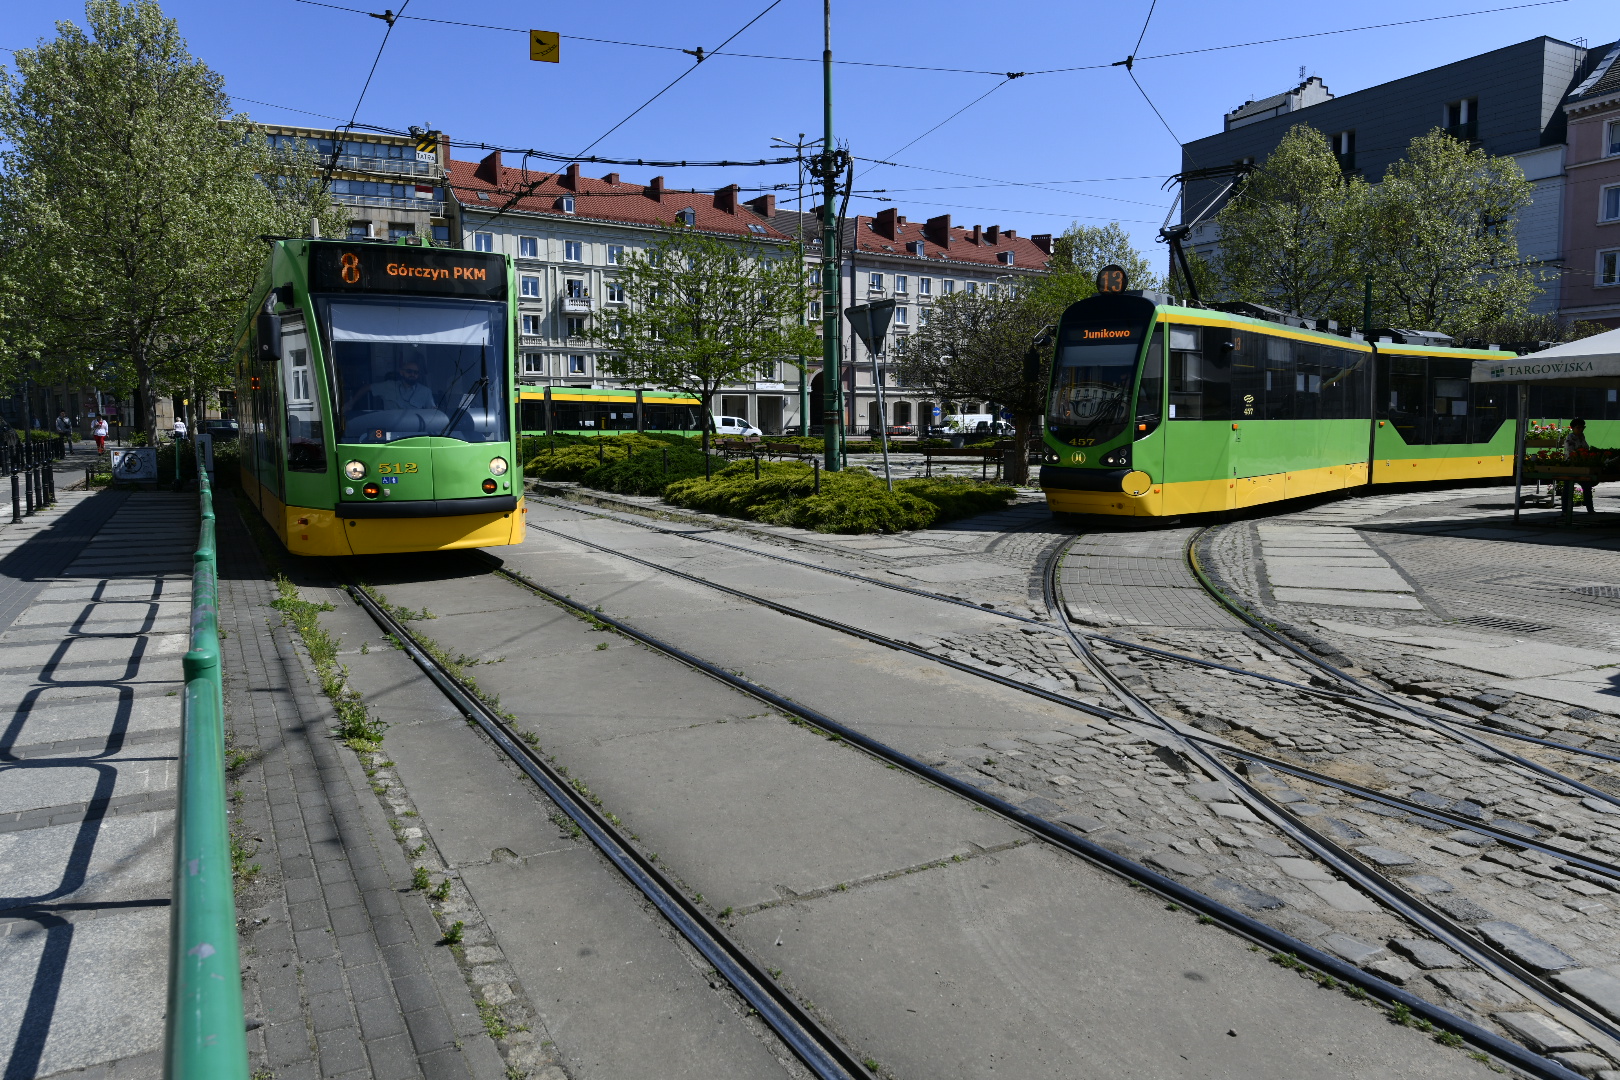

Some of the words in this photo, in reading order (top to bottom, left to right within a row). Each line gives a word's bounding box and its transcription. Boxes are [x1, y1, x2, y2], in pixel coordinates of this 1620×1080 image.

[340, 252, 360, 284] 8
[386, 263, 449, 281] Górczyn
[453, 266, 487, 281] PKM
[1101, 270, 1124, 292] 13
[1083, 328, 1131, 339] Junikowo
[1507, 361, 1594, 376] TARGOWISKA
[375, 429, 383, 438] 8
[1069, 438, 1096, 446] 457
[378, 462, 419, 474] 512
